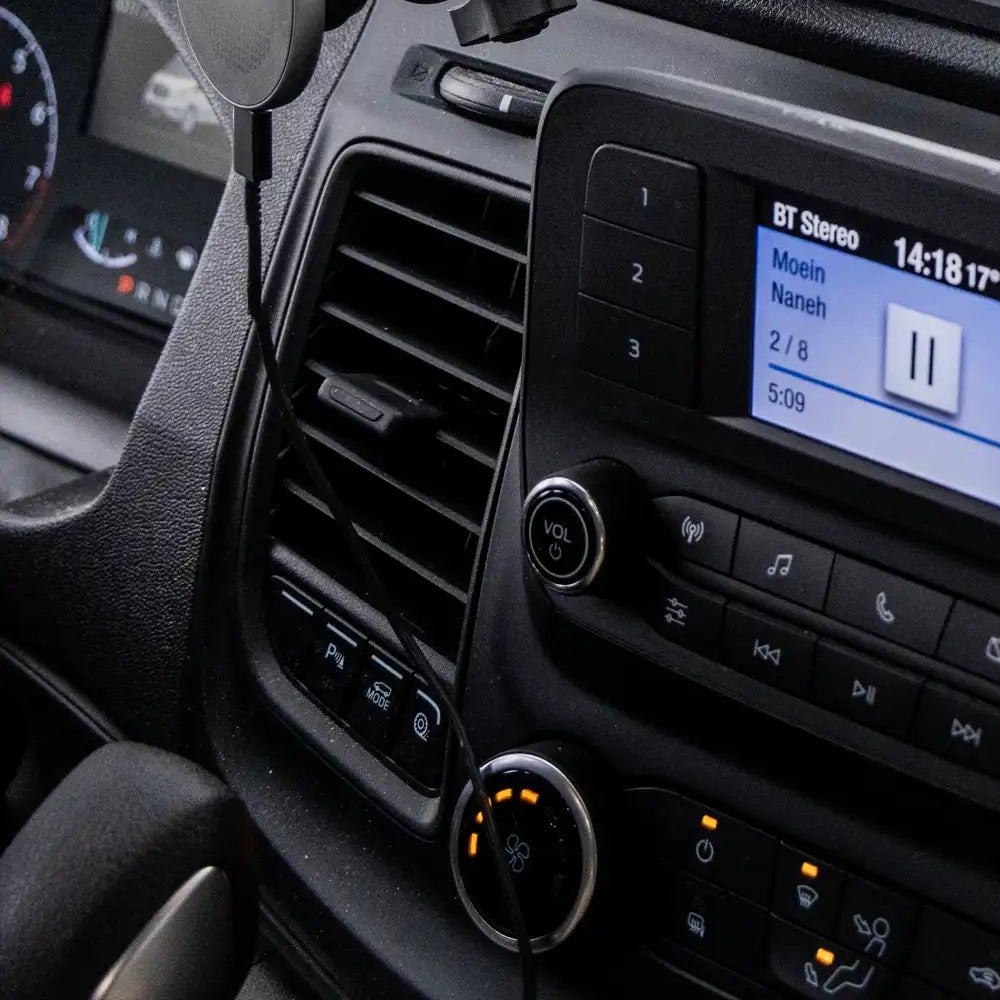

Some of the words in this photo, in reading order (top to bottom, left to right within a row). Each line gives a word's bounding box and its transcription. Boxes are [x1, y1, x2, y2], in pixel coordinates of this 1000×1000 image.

[641, 186, 648, 207] 1
[772, 200, 797, 231] BT
[800, 210, 860, 251] Stereo
[894, 236, 963, 286] 14:18
[632, 262, 643, 284] 2
[772, 247, 826, 284] Moein
[771, 281, 827, 320] Naneh
[628, 338, 640, 359] 3
[769, 330, 780, 353] 2
[798, 339, 809, 362] 8
[768, 383, 806, 414] 5:09
[544, 519, 573, 544] VOL
[366, 687, 391, 712] MODE
